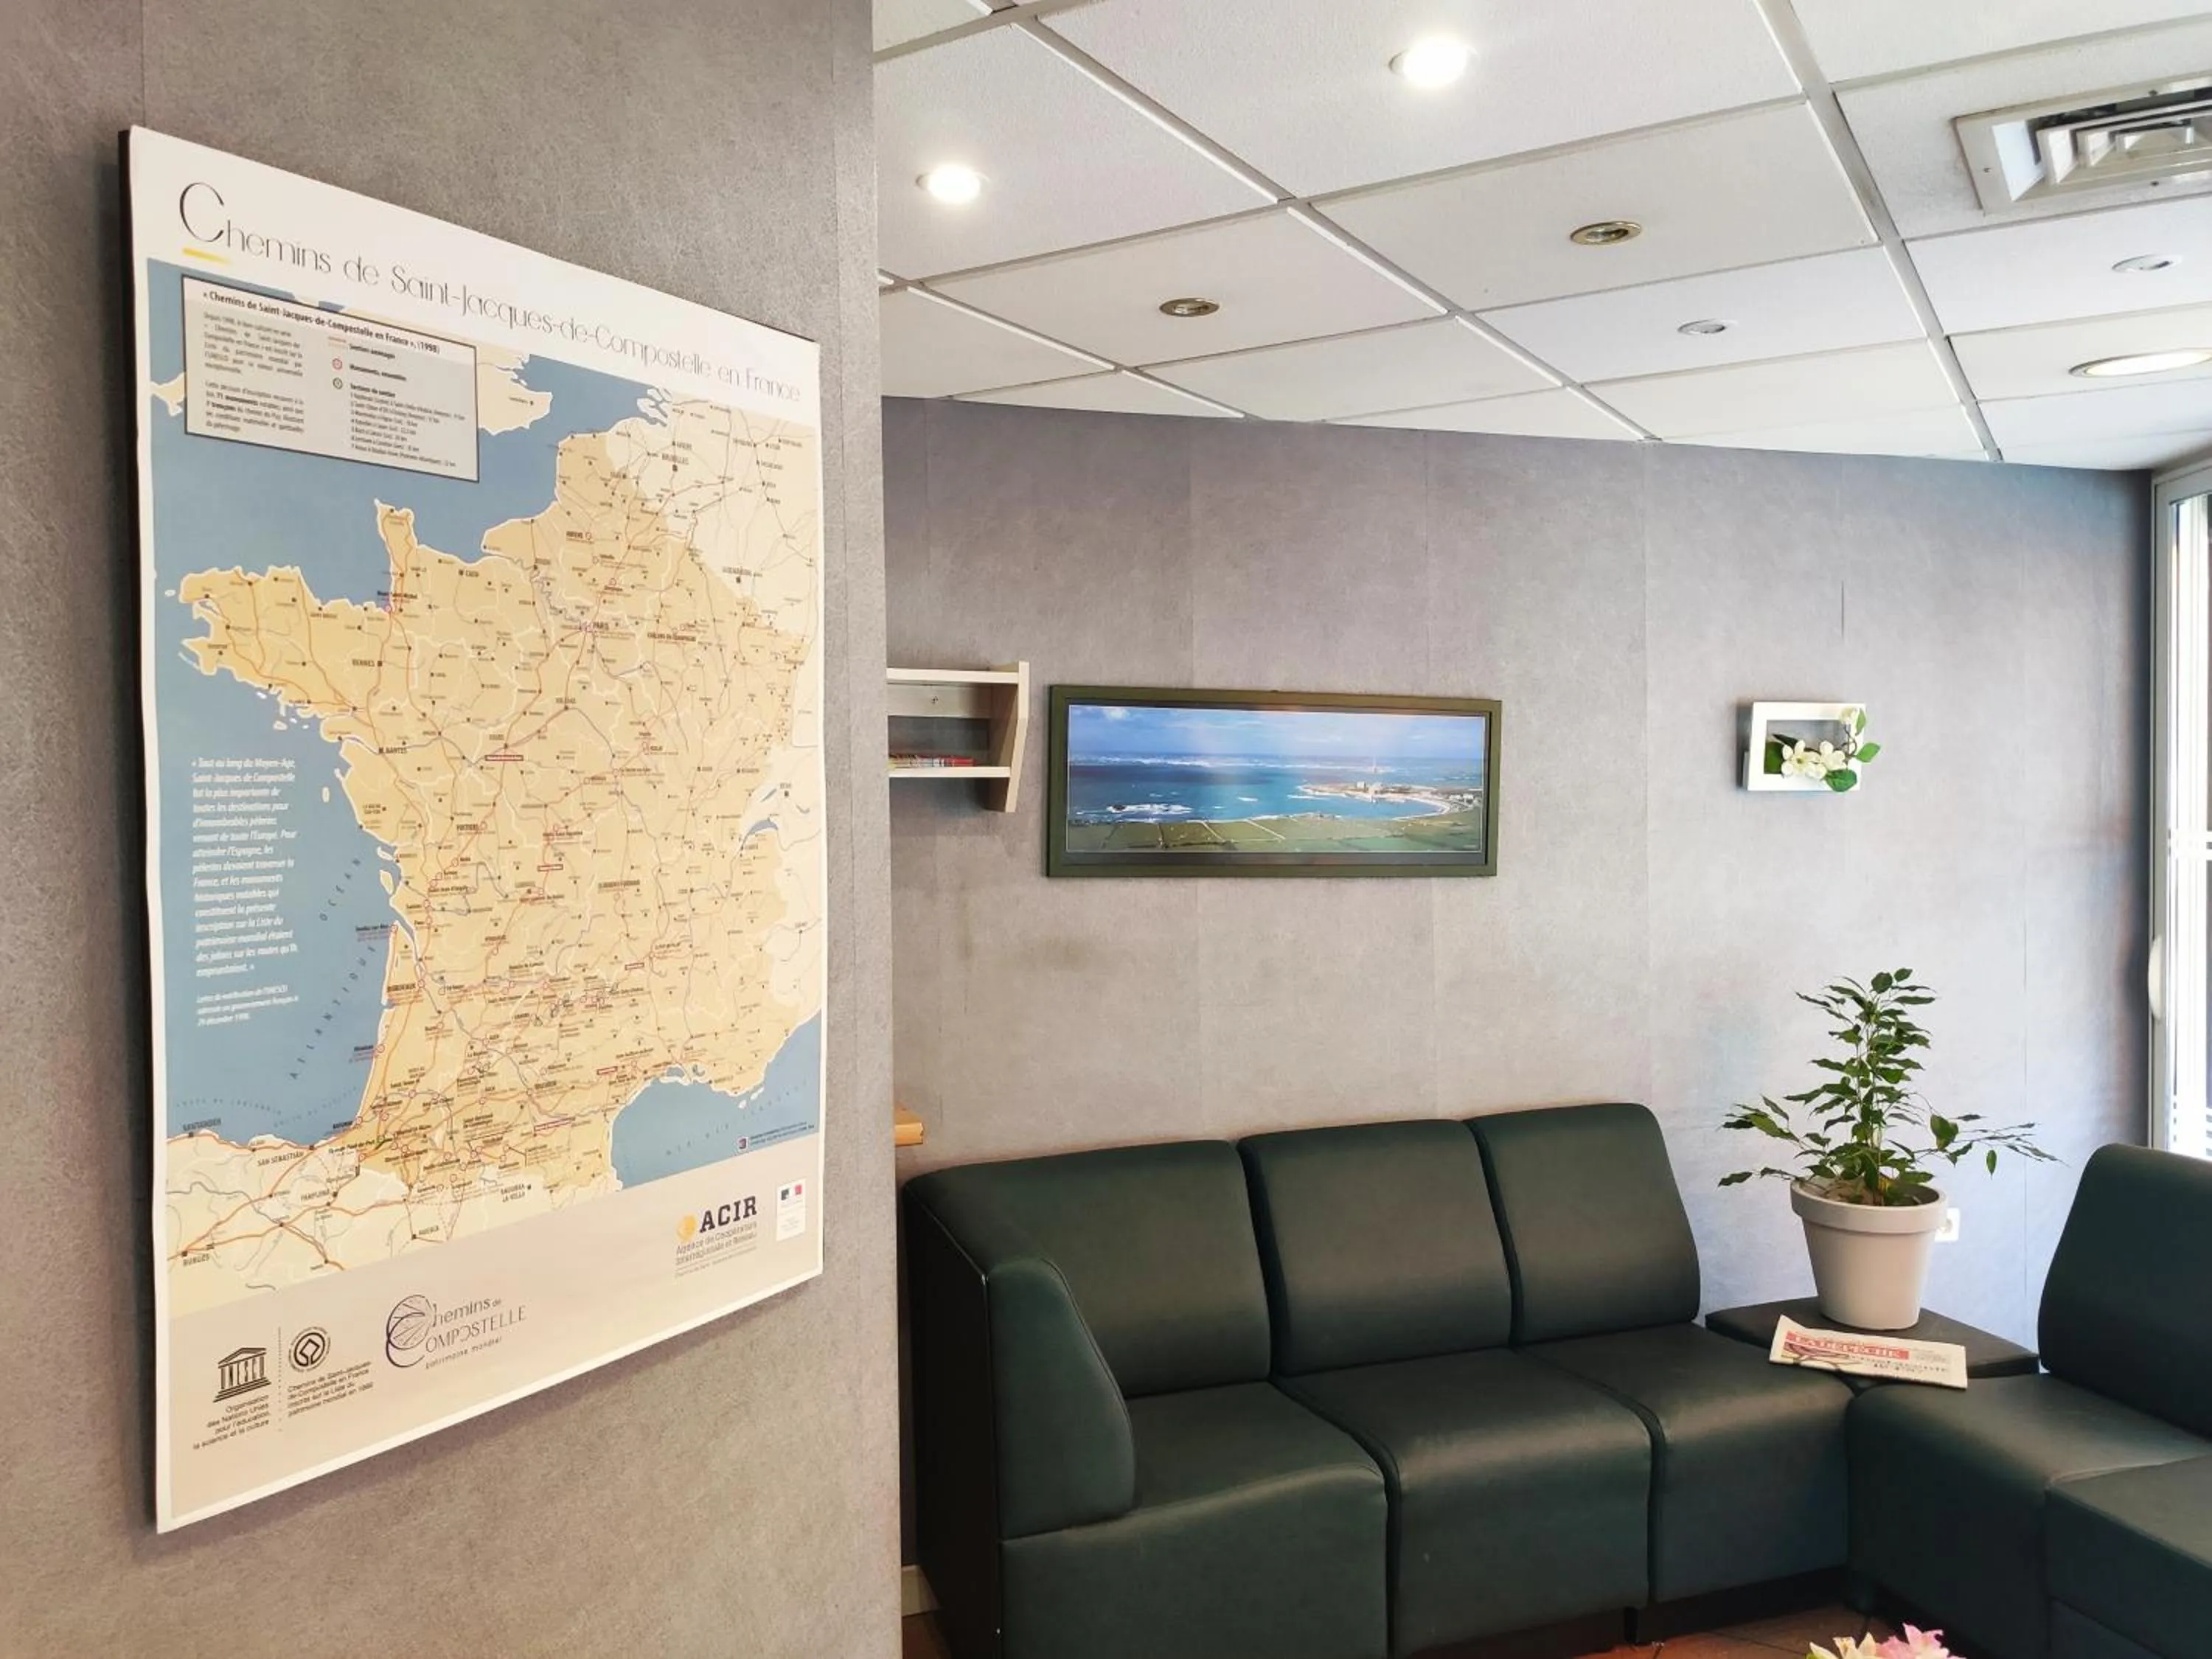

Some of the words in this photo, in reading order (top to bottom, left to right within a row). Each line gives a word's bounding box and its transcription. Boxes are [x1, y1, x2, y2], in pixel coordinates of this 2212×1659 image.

[179, 181, 332, 272] Chemins
[344, 256, 380, 285] de
[391, 265, 714, 379] Saint-Jacques-de-Compostelle
[717, 364, 740, 385] en
[745, 369, 801, 402] France
[209, 289, 246, 307] Chemins
[247, 299, 257, 310] de
[375, 331, 386, 341] en
[386, 333, 408, 346] France
[699, 1195, 757, 1234] ACIR
